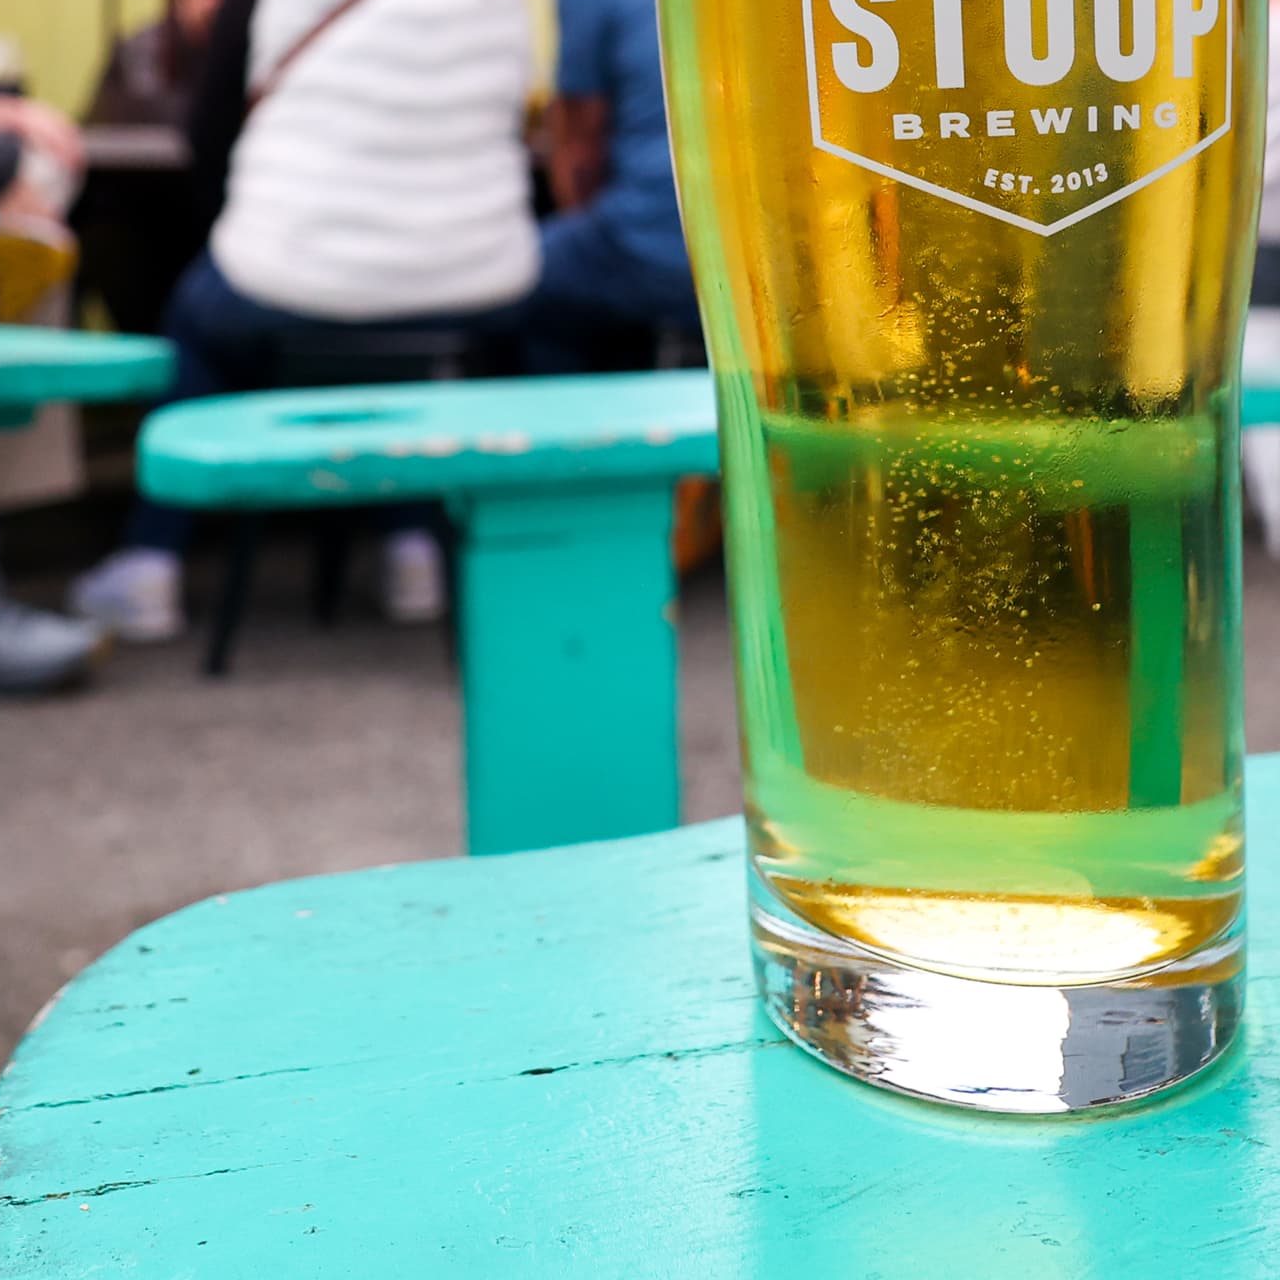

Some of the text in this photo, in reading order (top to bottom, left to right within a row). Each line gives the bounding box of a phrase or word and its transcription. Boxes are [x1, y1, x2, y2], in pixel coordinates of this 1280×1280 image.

[892, 102, 1178, 140] BREWING
[983, 163, 1110, 195] EST. 2013
